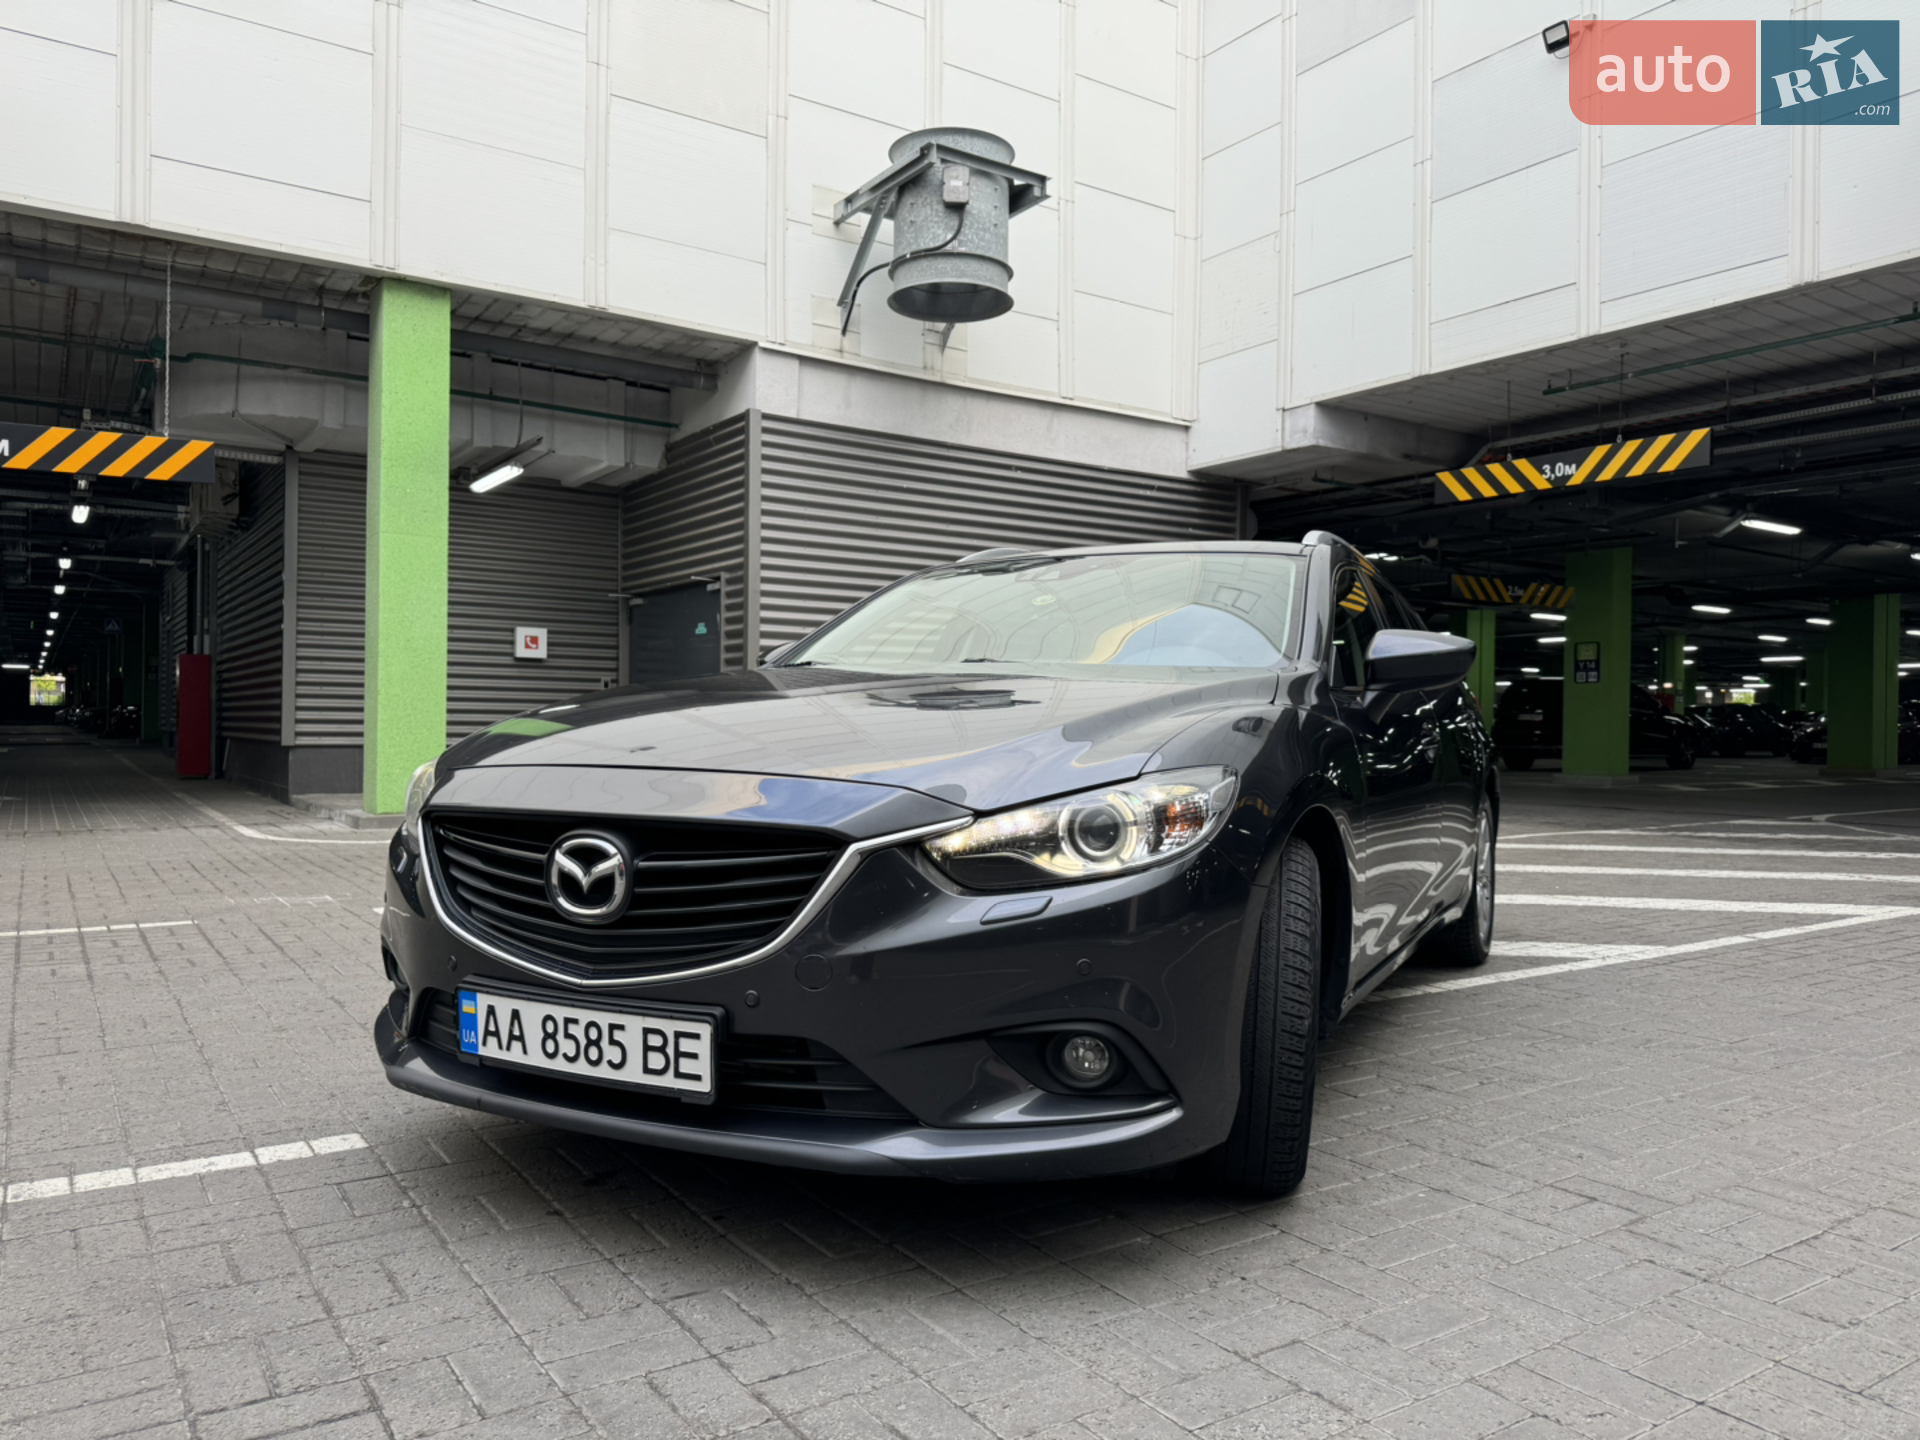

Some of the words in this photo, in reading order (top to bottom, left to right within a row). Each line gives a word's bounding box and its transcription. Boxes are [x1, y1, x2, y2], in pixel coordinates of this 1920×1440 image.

[462, 1029, 477, 1044] UA
[482, 1004, 528, 1055] AA
[541, 1013, 627, 1070] 8585
[642, 1026, 702, 1082] BE
